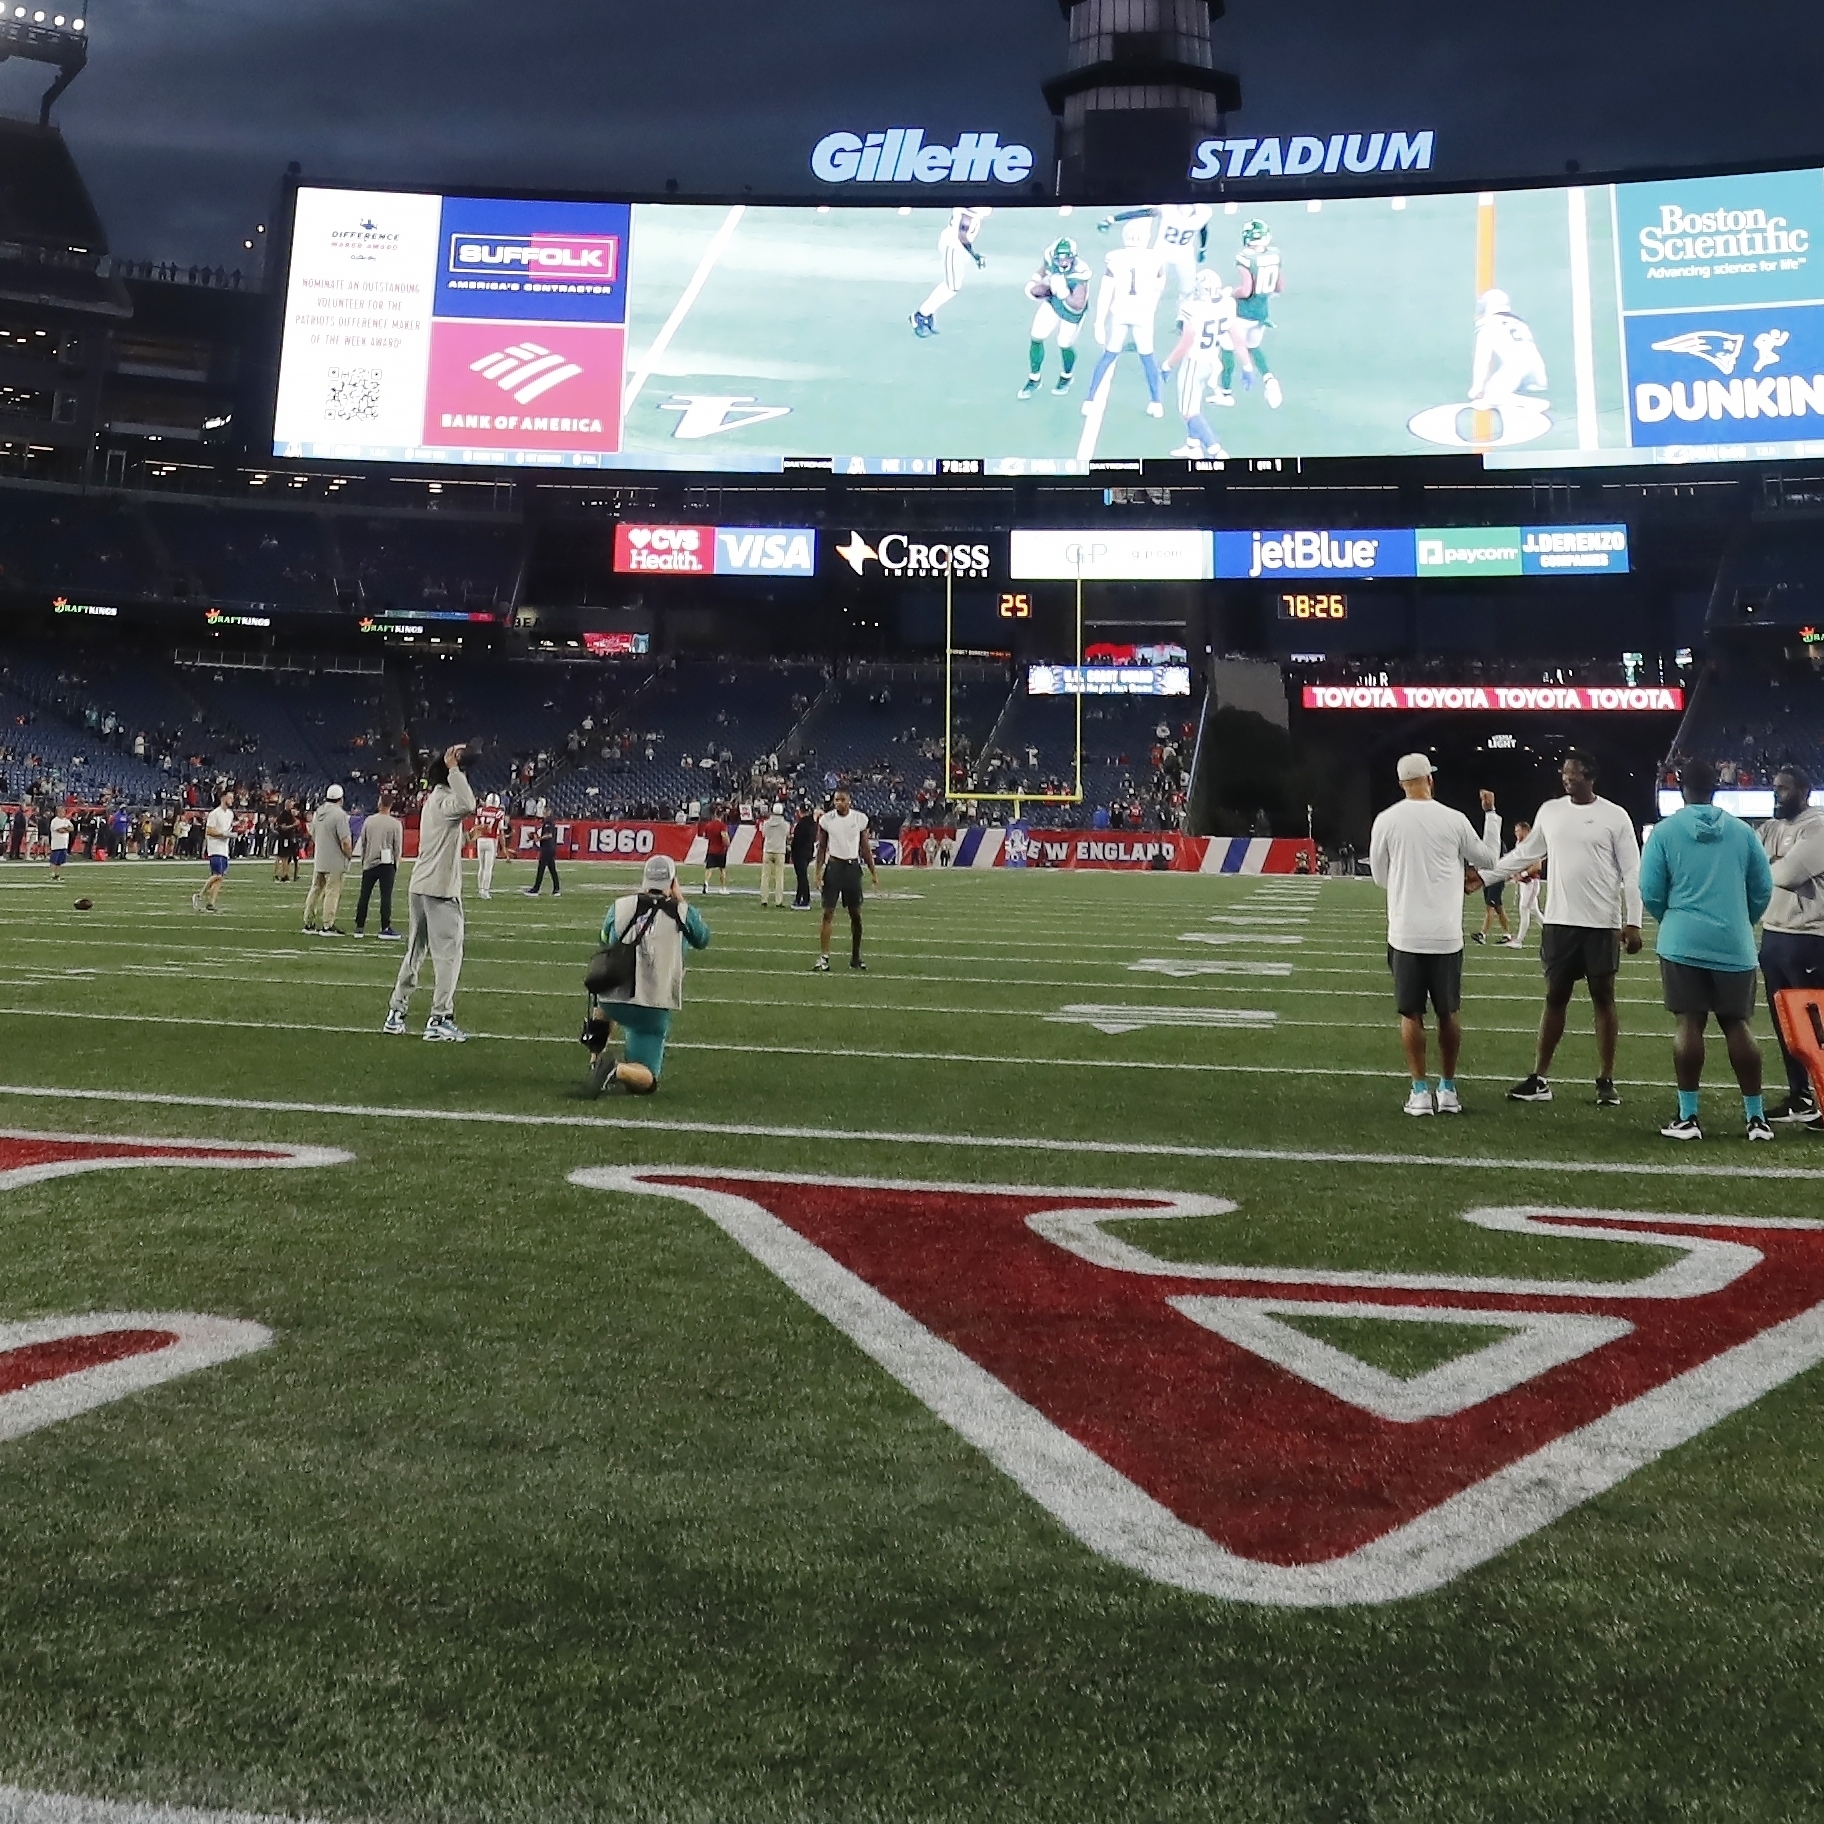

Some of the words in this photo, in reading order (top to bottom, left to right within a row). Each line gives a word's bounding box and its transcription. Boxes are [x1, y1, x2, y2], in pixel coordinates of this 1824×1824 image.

[810, 127, 1035, 184] Gillette
[1190, 129, 1435, 180] STADIUM
[1659, 205, 1768, 236] Boston
[331, 230, 401, 242] DIFFERENCE
[1638, 216, 1810, 264] Scientific
[457, 244, 604, 268] SUFFOLK
[1646, 263, 1711, 278] Advancing
[1712, 262, 1758, 276] science
[1759, 260, 1777, 272] for
[302, 278, 345, 290] NOMINATE
[347, 281, 360, 291] AN
[362, 281, 421, 294] OUTSTANDING
[447, 279, 521, 291] AMERICA'S
[522, 282, 613, 294] CONTRACTOR
[317, 297, 365, 310] VOLUNTEER
[367, 299, 384, 311] FOR
[387, 300, 403, 312] THE
[295, 314, 335, 327] PATRIOTS
[338, 316, 388, 330] DIFFERENCE
[391, 319, 421, 331] MAKER
[310, 333, 321, 345] OF
[325, 334, 341, 346] THE
[344, 335, 367, 347] WEEK
[1199, 316, 1229, 351] 55
[441, 413, 491, 430] BANK
[493, 415, 518, 430] OF
[518, 416, 604, 433] AMERICA
[651, 529, 700, 550] CVS
[1523, 532, 1625, 554] J.DERENZO
[629, 549, 703, 572] Health.
[717, 534, 811, 570] VISA
[1248, 530, 1378, 577] jetBlue
[1444, 545, 1519, 566] paycom
[1540, 553, 1610, 568] COMPANIES
[53, 600, 118, 617] DRAFTKINGS
[1000, 594, 1030, 617] 25
[1282, 594, 1344, 618] 78:26
[205, 612, 271, 628] DRAFTKINGS
[360, 621, 424, 635] DRAFTKINGS
[1312, 686, 1397, 709] TOYOTA
[1403, 686, 1489, 709] TOYOTA
[1494, 686, 1581, 709] TOYOTA
[1587, 686, 1675, 709] TOYOTA
[1487, 738, 1516, 749] LIGHT
[588, 828, 654, 854] 1960
[1076, 841, 1176, 862] ENGLAND
